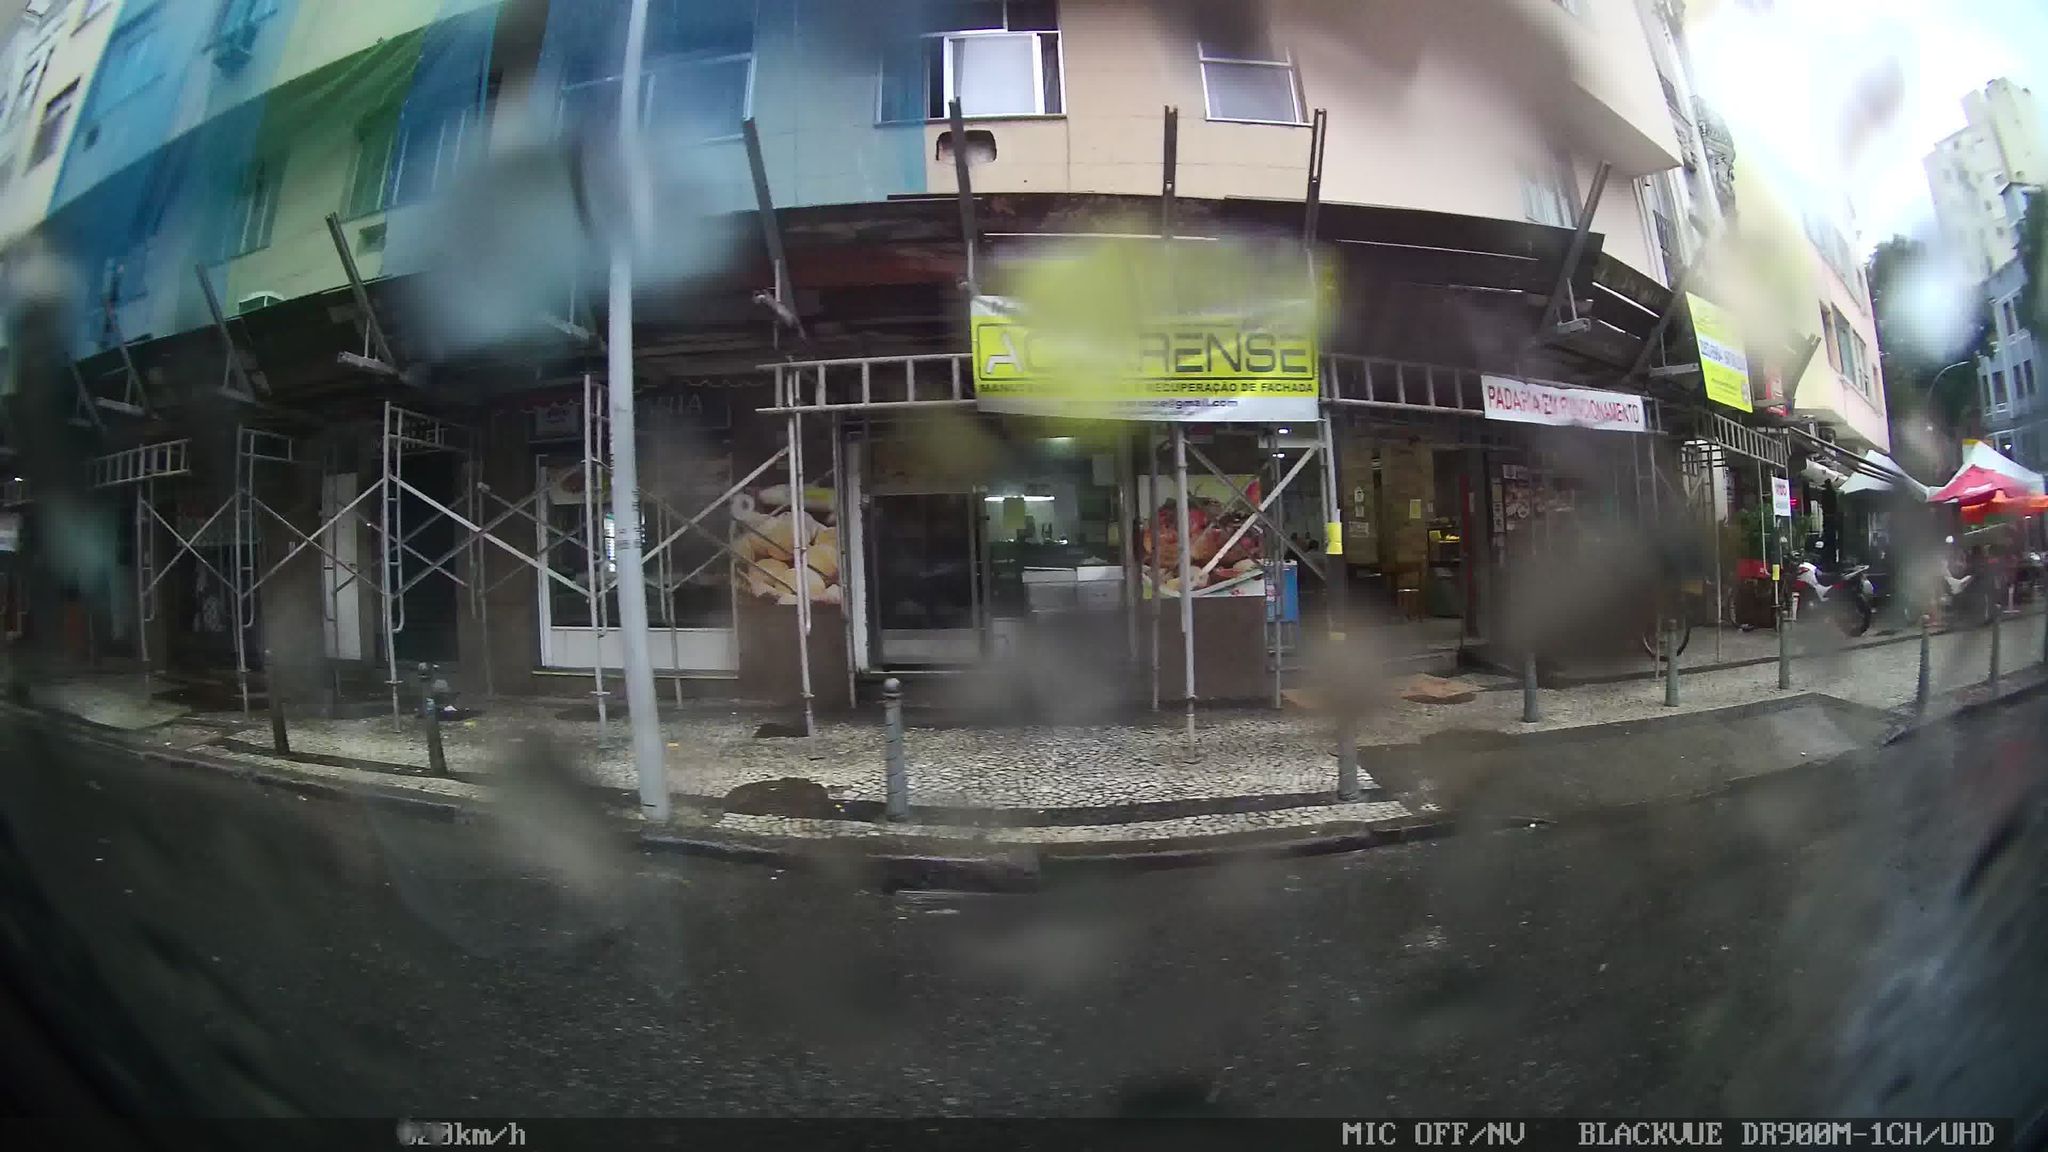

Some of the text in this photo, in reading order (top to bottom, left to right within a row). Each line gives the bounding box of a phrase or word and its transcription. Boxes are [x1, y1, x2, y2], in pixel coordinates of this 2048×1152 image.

[984, 331, 1308, 375] ACRENSE
[1240, 382, 1257, 392] DE
[1261, 382, 1314, 393] FACHADA
[1487, 385, 1540, 412] PADARA
[1560, 396, 1640, 424] ONAMENTO
